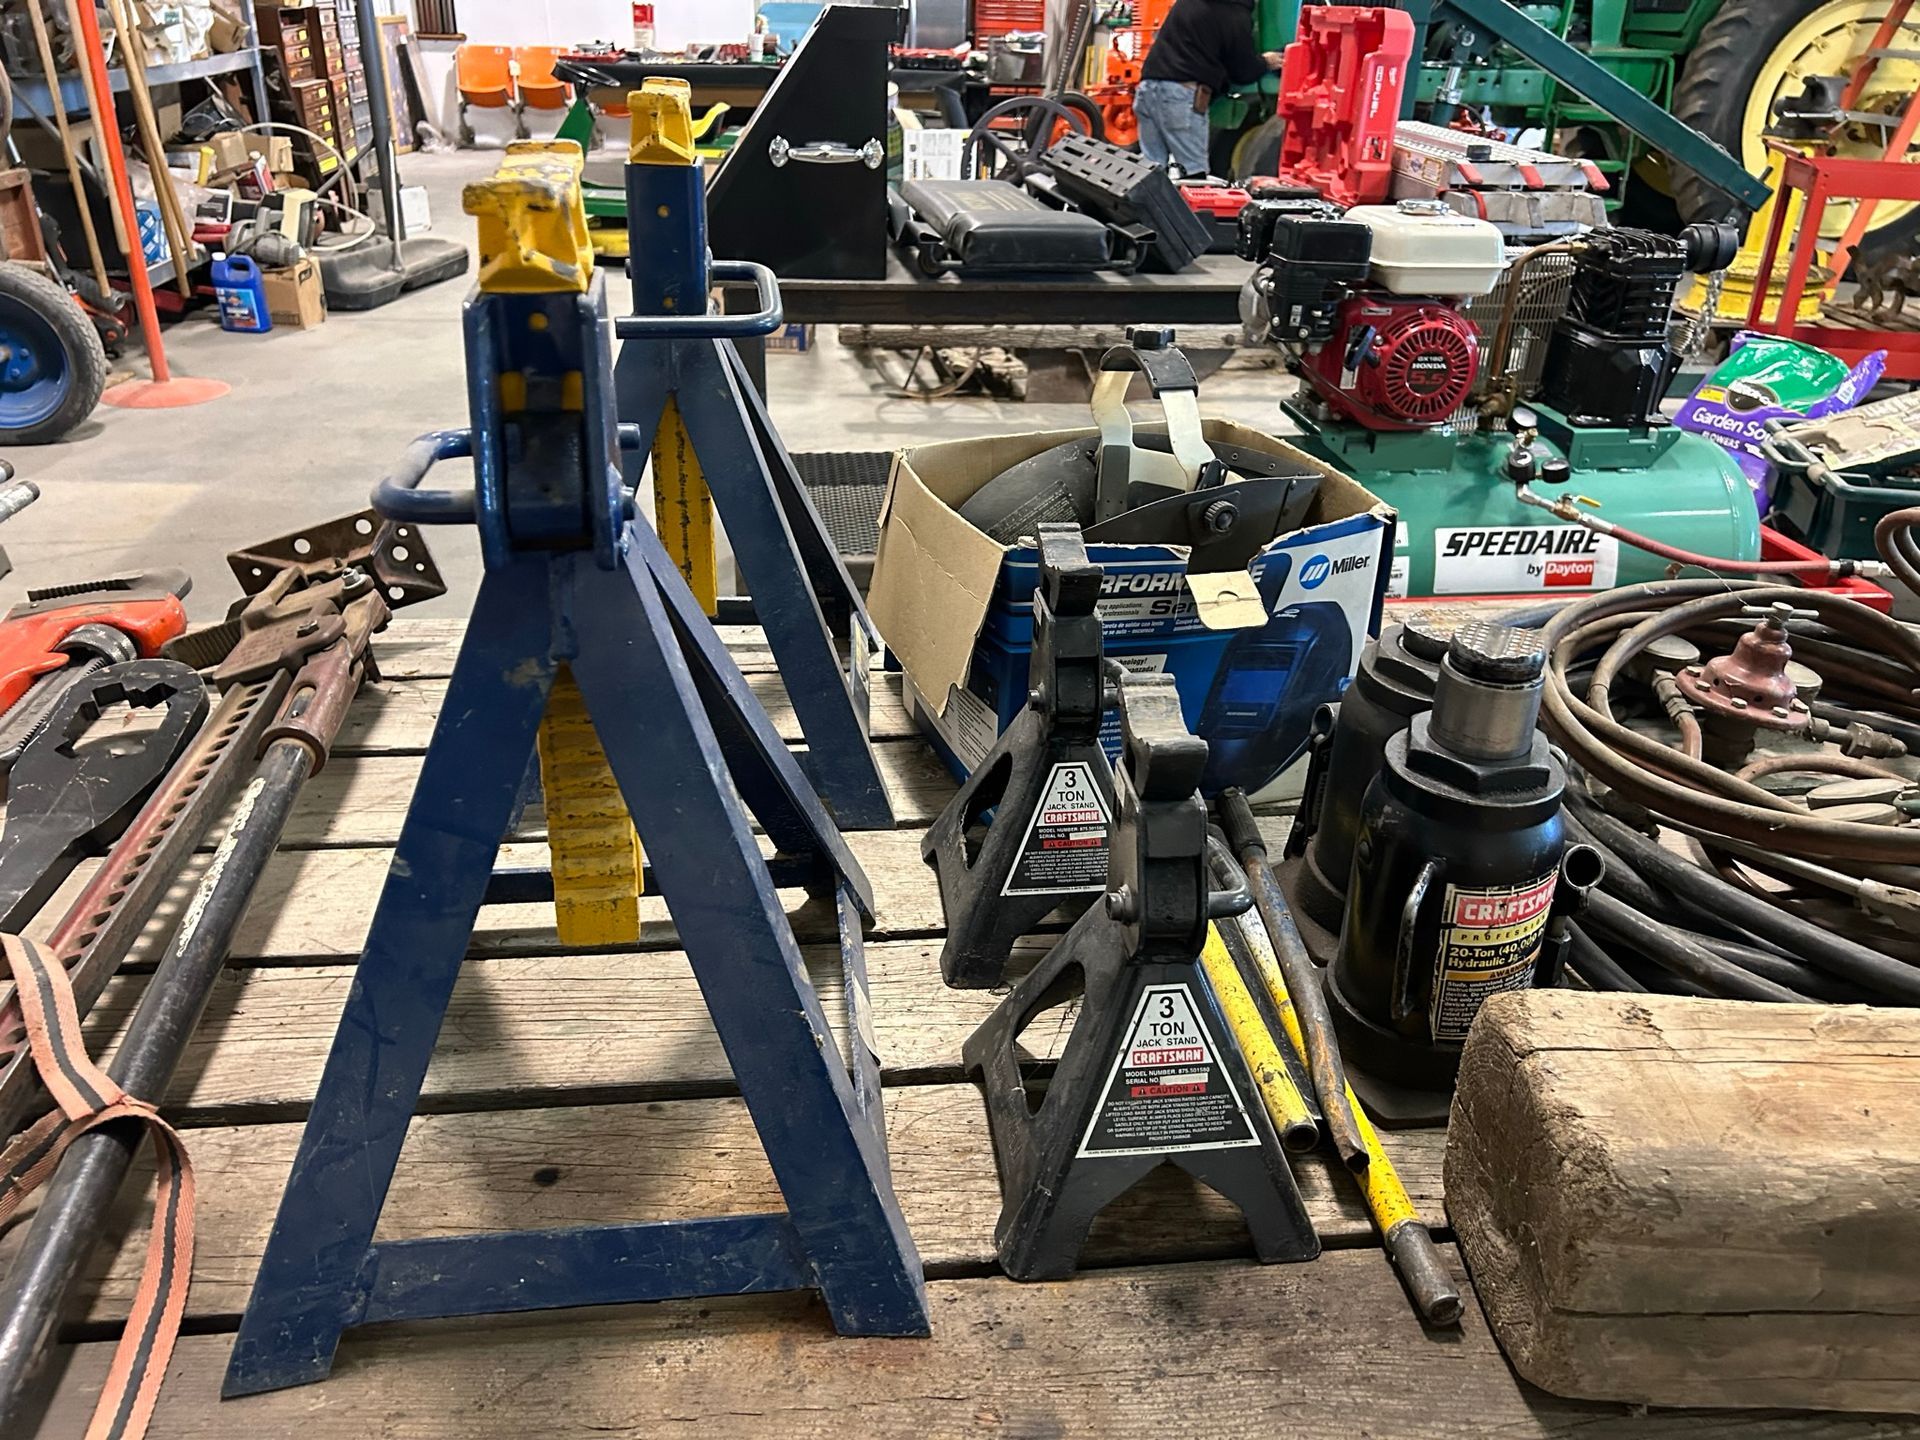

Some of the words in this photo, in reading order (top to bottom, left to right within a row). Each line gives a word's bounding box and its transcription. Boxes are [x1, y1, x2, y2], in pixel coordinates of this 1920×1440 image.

[1411, 371, 1444, 385] 5.5
[1692, 406, 1744, 435] Garden
[1702, 430, 1740, 449] FLOWERS
[1442, 530, 1601, 557] SPEEDAIRE
[1331, 555, 1371, 576] Miller
[1527, 563, 1543, 577] by
[1546, 562, 1594, 576] Dayton
[1064, 770, 1077, 788] 3
[1057, 790, 1085, 802] TON
[1045, 811, 1098, 823] CRAFTSMAN
[1450, 947, 1495, 958] 20-Ton
[1448, 955, 1505, 969] Hydraulic
[1159, 996, 1175, 1019] 3
[1149, 1021, 1185, 1037] TON
[1136, 1038, 1162, 1048] JACK
[1166, 1036, 1198, 1046] STAND
[1134, 1049, 1202, 1065] CRAFTSMAN
[1125, 1077, 1148, 1085] SERIAL
[1150, 1086, 1189, 1095] CAUTION
